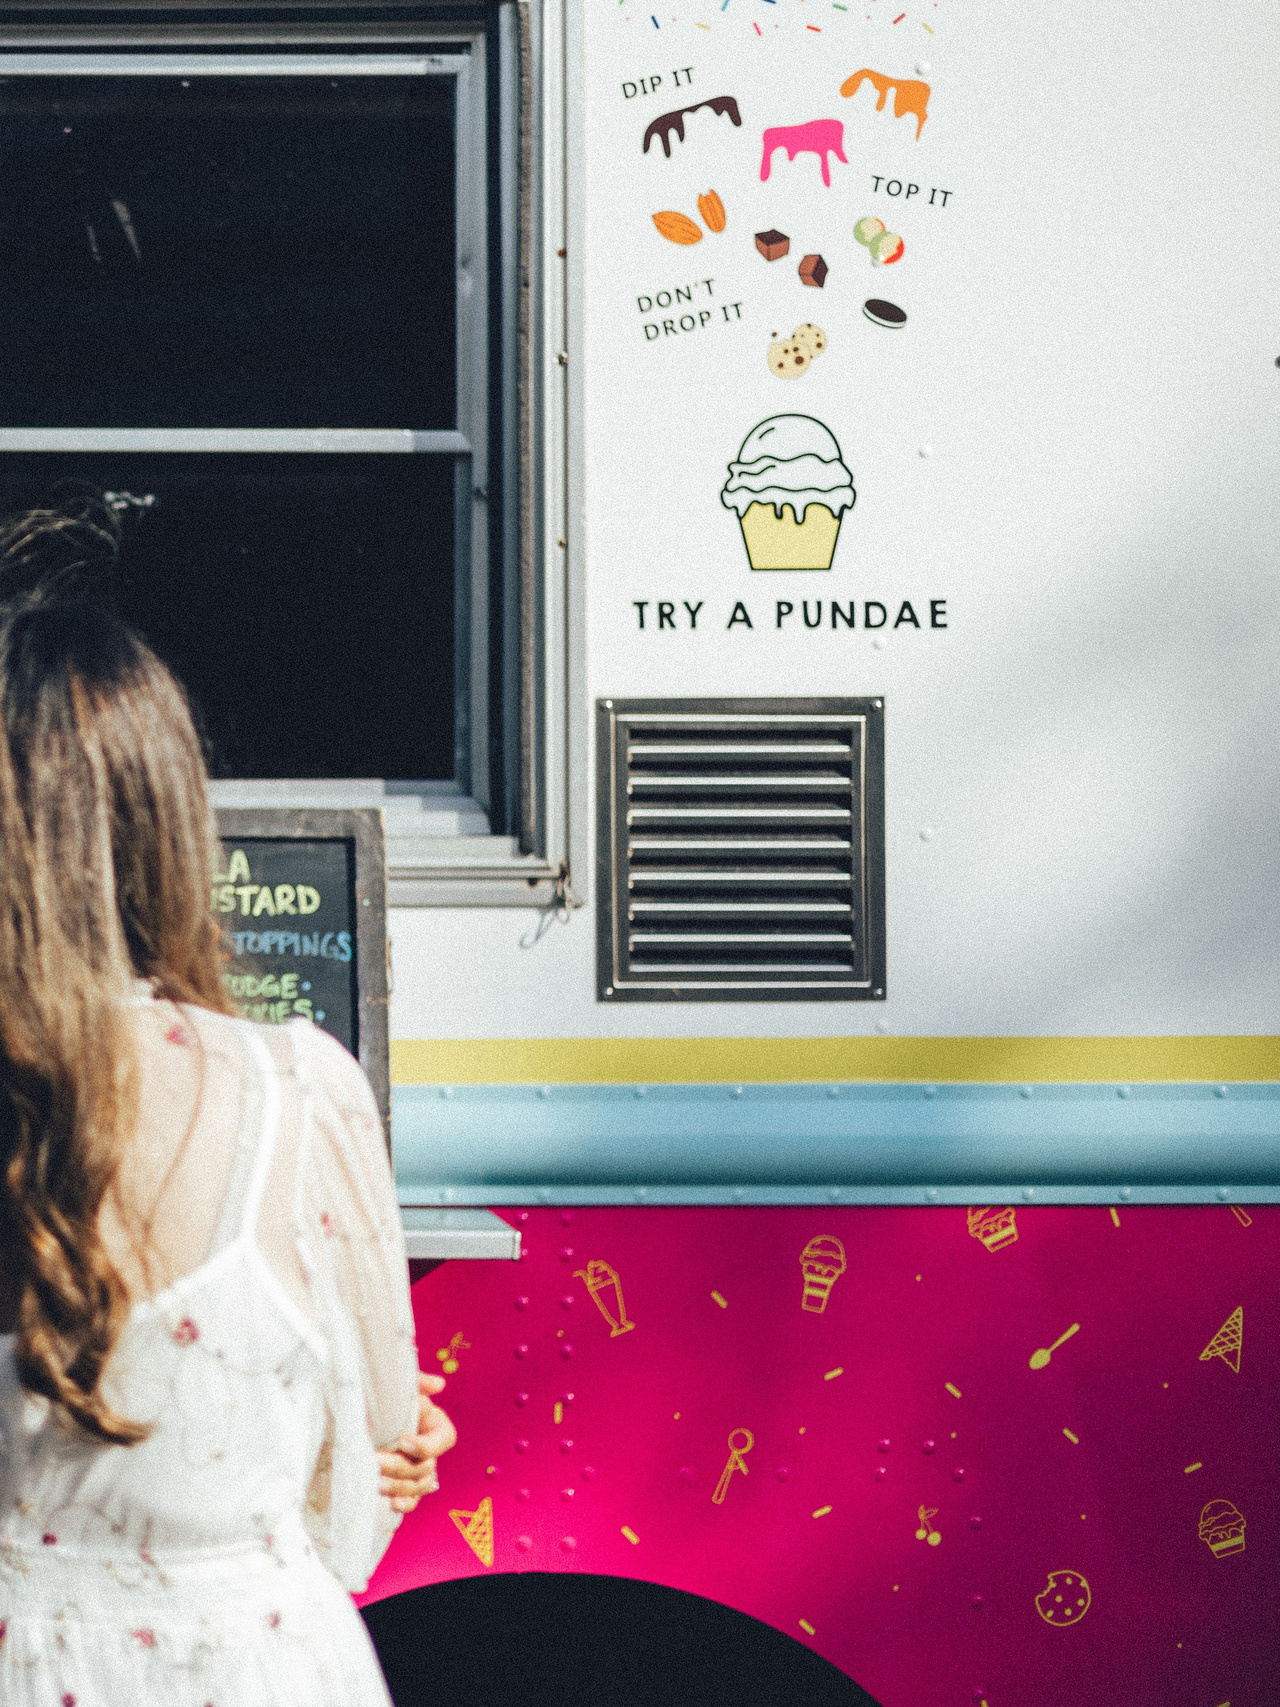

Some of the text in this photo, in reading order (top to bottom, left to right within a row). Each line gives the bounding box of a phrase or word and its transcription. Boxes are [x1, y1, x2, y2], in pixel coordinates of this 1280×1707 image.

[622, 67, 693, 98] DIP IT
[872, 175, 953, 207] TOP IT
[637, 279, 715, 312] DON'T
[644, 302, 742, 340] DROP IT
[633, 600, 949, 629] TRY A PUNDAE
[232, 930, 352, 961] TOPPINGS
